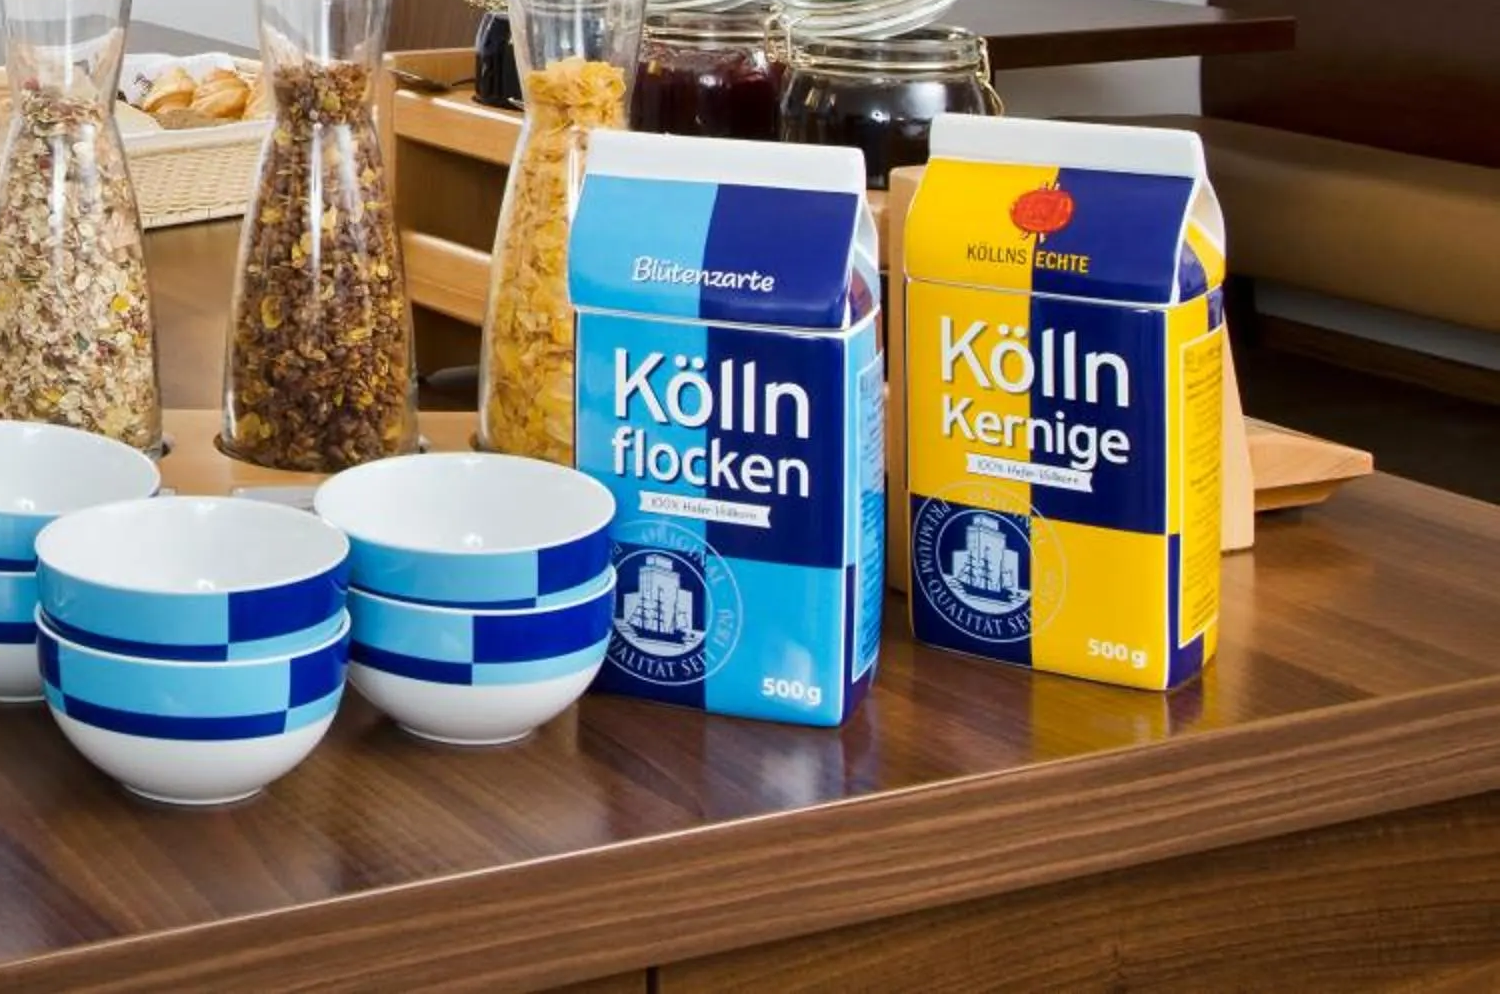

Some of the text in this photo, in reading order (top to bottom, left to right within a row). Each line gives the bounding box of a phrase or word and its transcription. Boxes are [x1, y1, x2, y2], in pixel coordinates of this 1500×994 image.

[632, 255, 775, 293] Blütenzarte
[966, 243, 1090, 274] KÖLLNS ECHTE
[613, 347, 811, 439] Kölln
[938, 315, 1130, 408] Kölln
[612, 426, 810, 498] flocken
[940, 392, 1132, 471] Kernige
[917, 500, 952, 574] PREMIUM
[1087, 638, 1129, 661] 500
